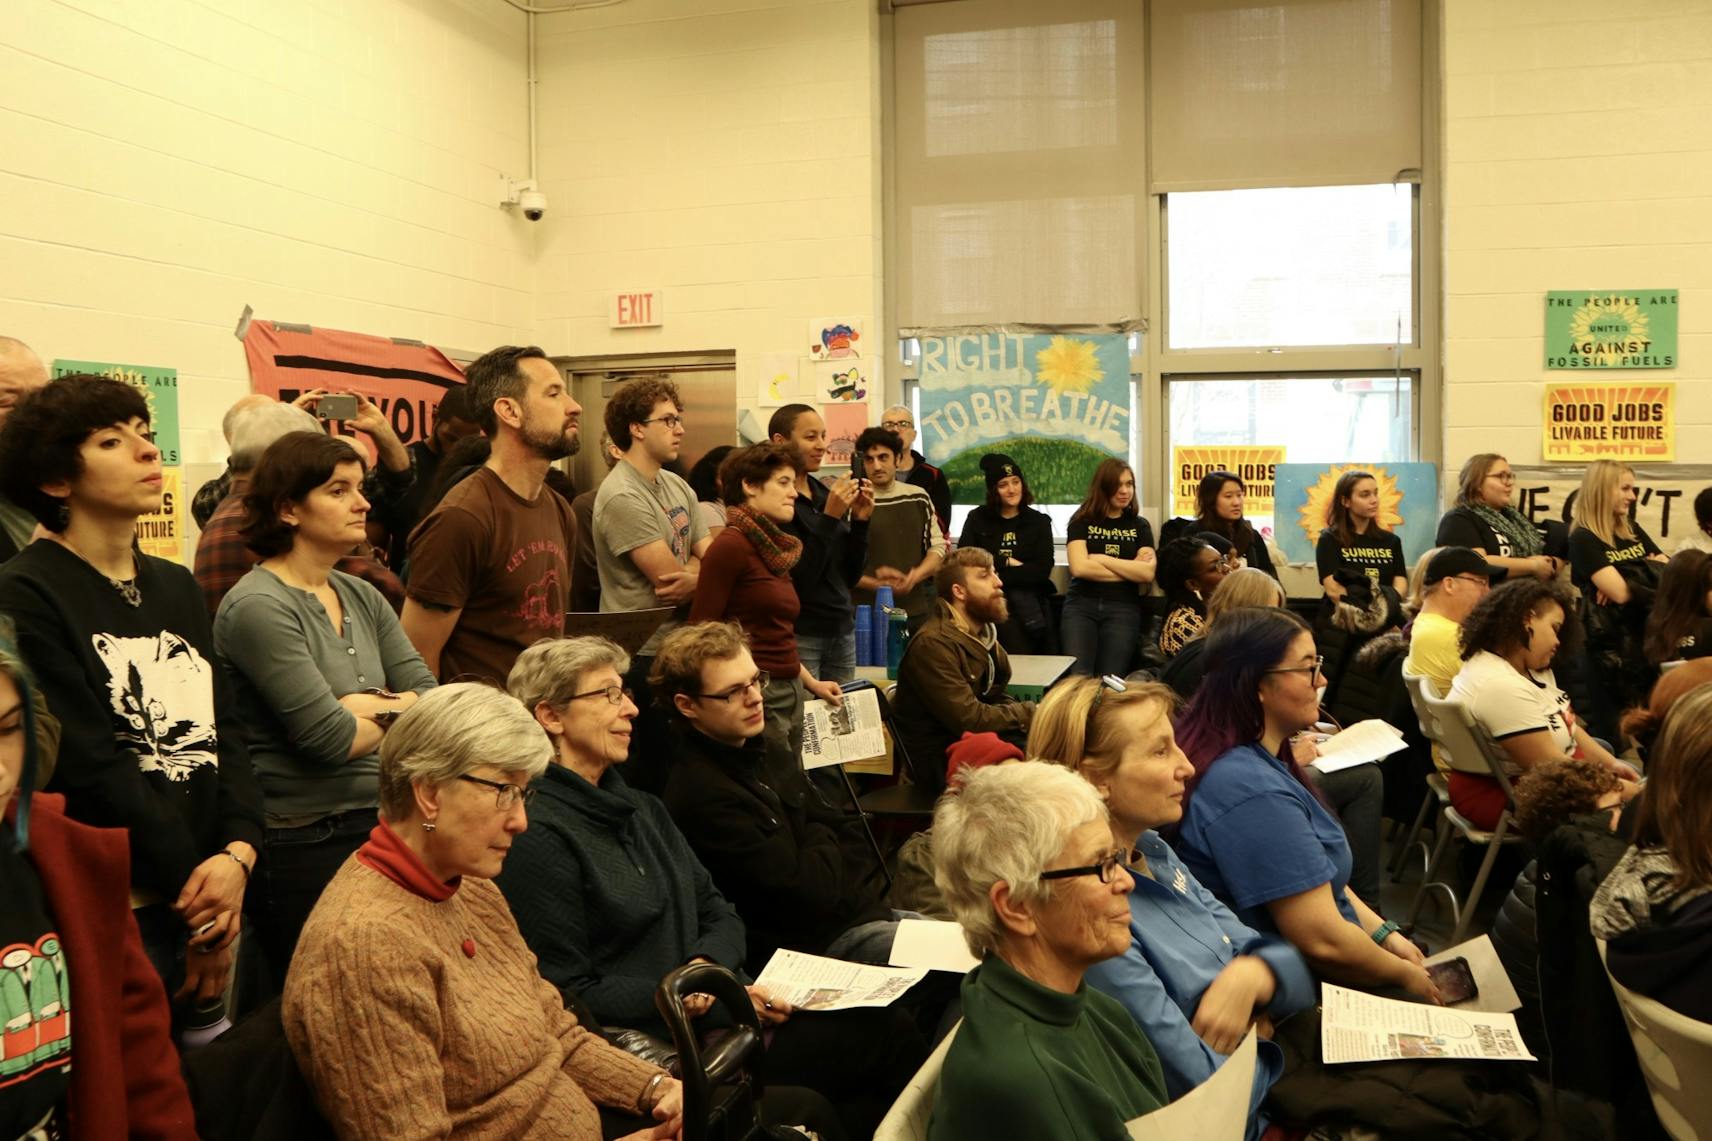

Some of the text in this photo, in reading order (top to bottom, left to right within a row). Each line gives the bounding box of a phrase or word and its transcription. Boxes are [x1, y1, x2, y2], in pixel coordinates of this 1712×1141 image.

[1548, 296, 1677, 307] THE PEOPLE ARE
[617, 293, 653, 324] EXIT
[1590, 325, 1628, 333] UNITED
[921, 334, 1034, 374] RIGHT
[1569, 341, 1652, 354] AGAINST
[1548, 356, 1673, 367] FOSSIL FUELS
[155, 377, 177, 387] ARE
[921, 388, 1129, 441] TO BREATHE
[1553, 403, 1664, 422] GOOD JOBS
[1552, 426, 1663, 440] LIVABLE FUTURE
[136, 521, 175, 538] UTURE
[1088, 525, 1138, 538] SUNRISE
[1341, 547, 1393, 558] SUNRISE
